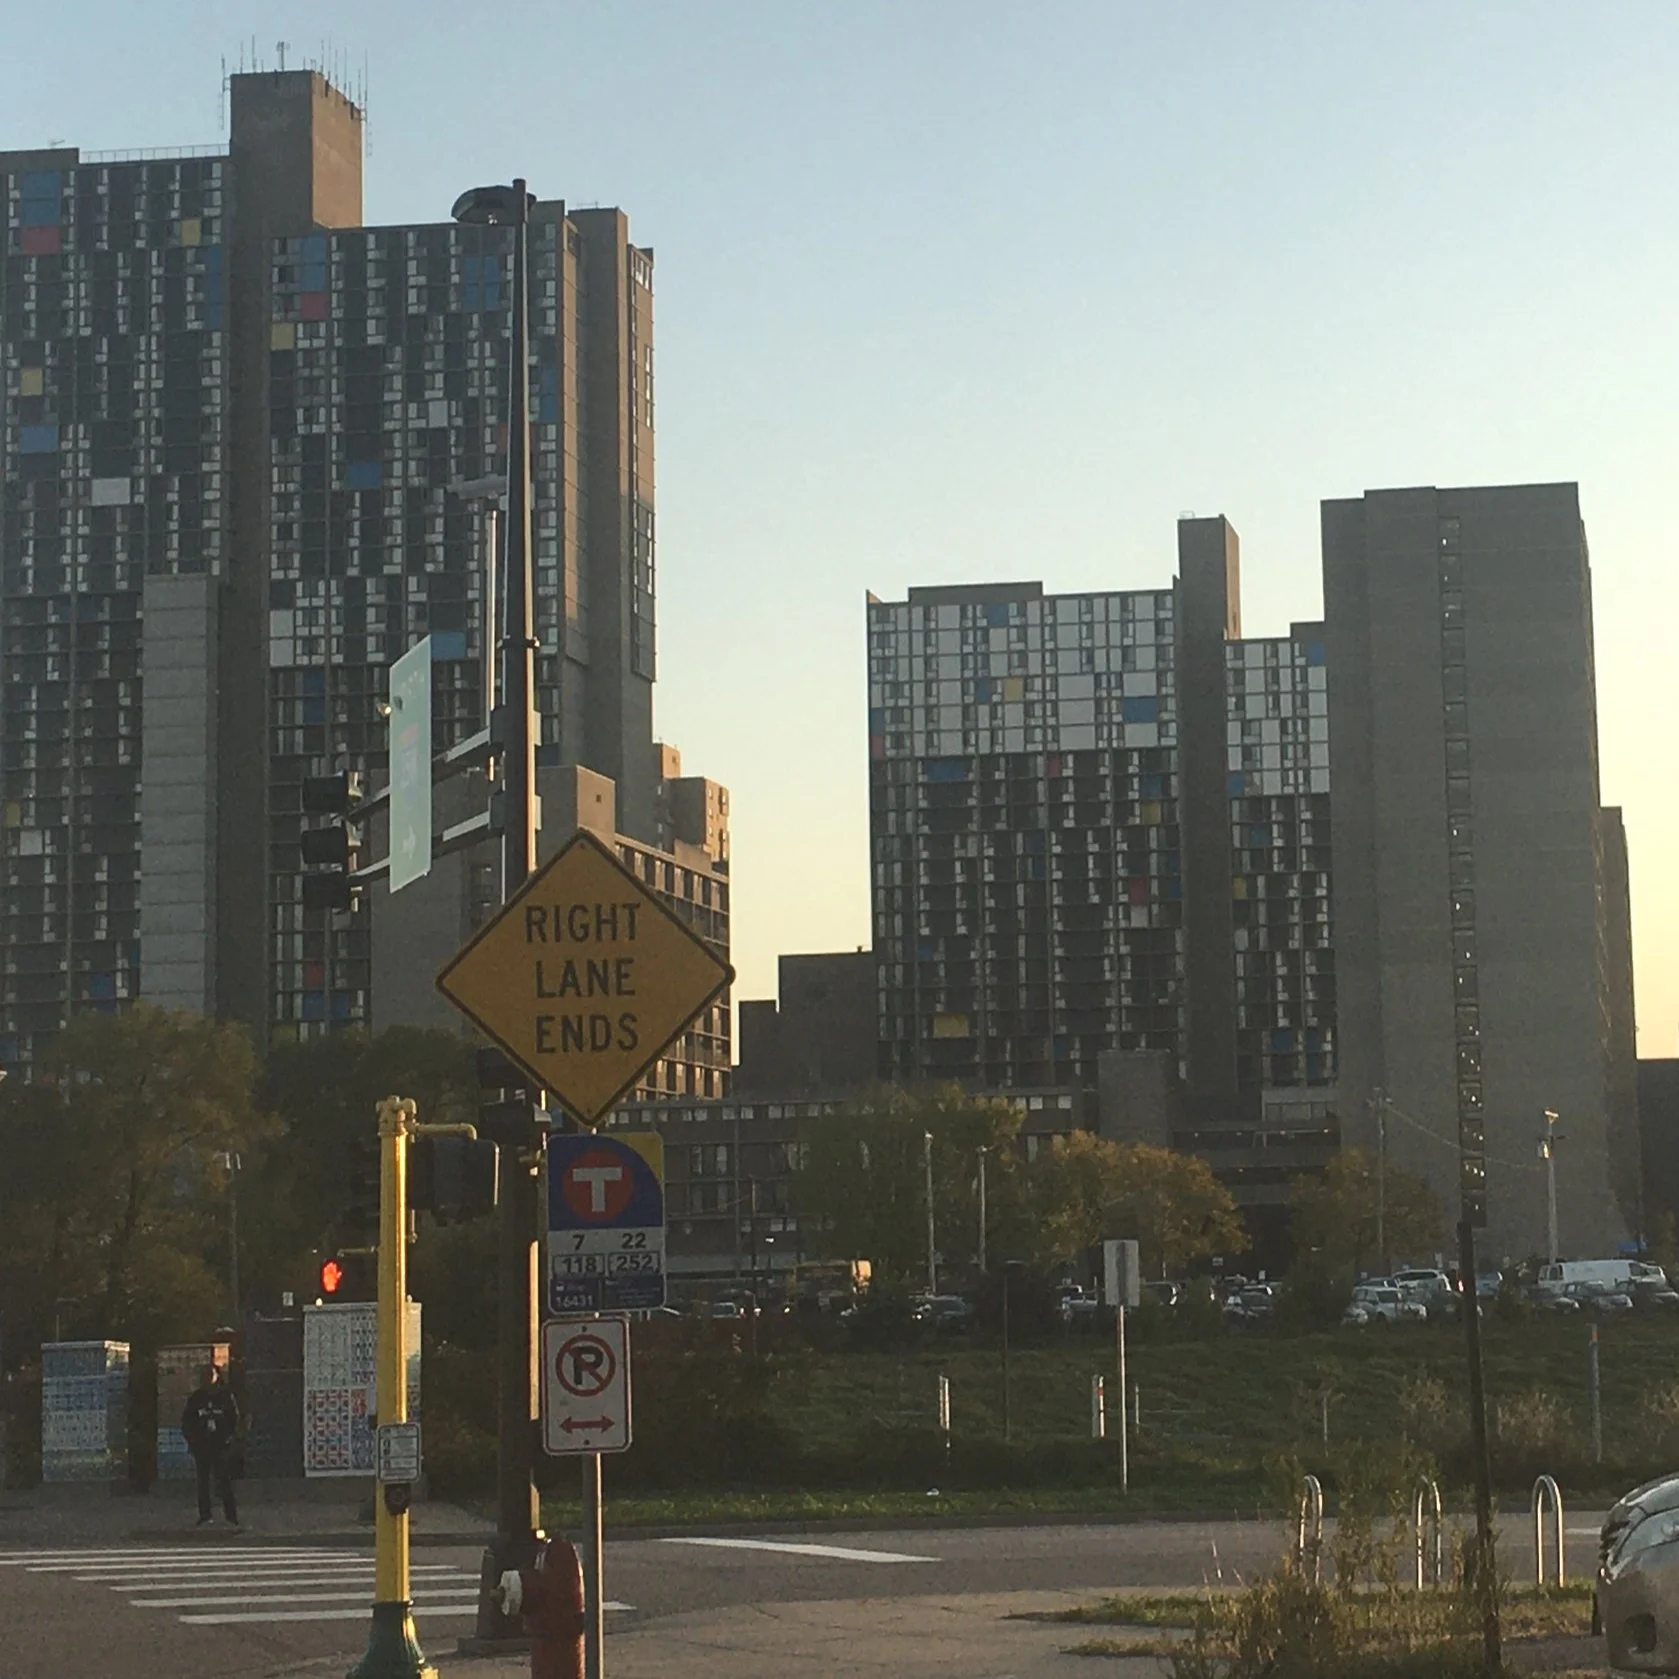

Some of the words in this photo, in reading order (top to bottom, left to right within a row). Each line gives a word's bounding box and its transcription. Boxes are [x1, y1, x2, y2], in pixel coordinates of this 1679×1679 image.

[526, 902, 641, 943] RIGHT
[536, 958, 636, 999] LANE
[536, 1013, 640, 1055] ENDS
[572, 1166, 623, 1213] T
[572, 1234, 586, 1252] 7
[621, 1233, 648, 1250] 22
[563, 1256, 597, 1273] 118
[616, 1254, 653, 1271] 252
[556, 1294, 594, 1309] 16431
